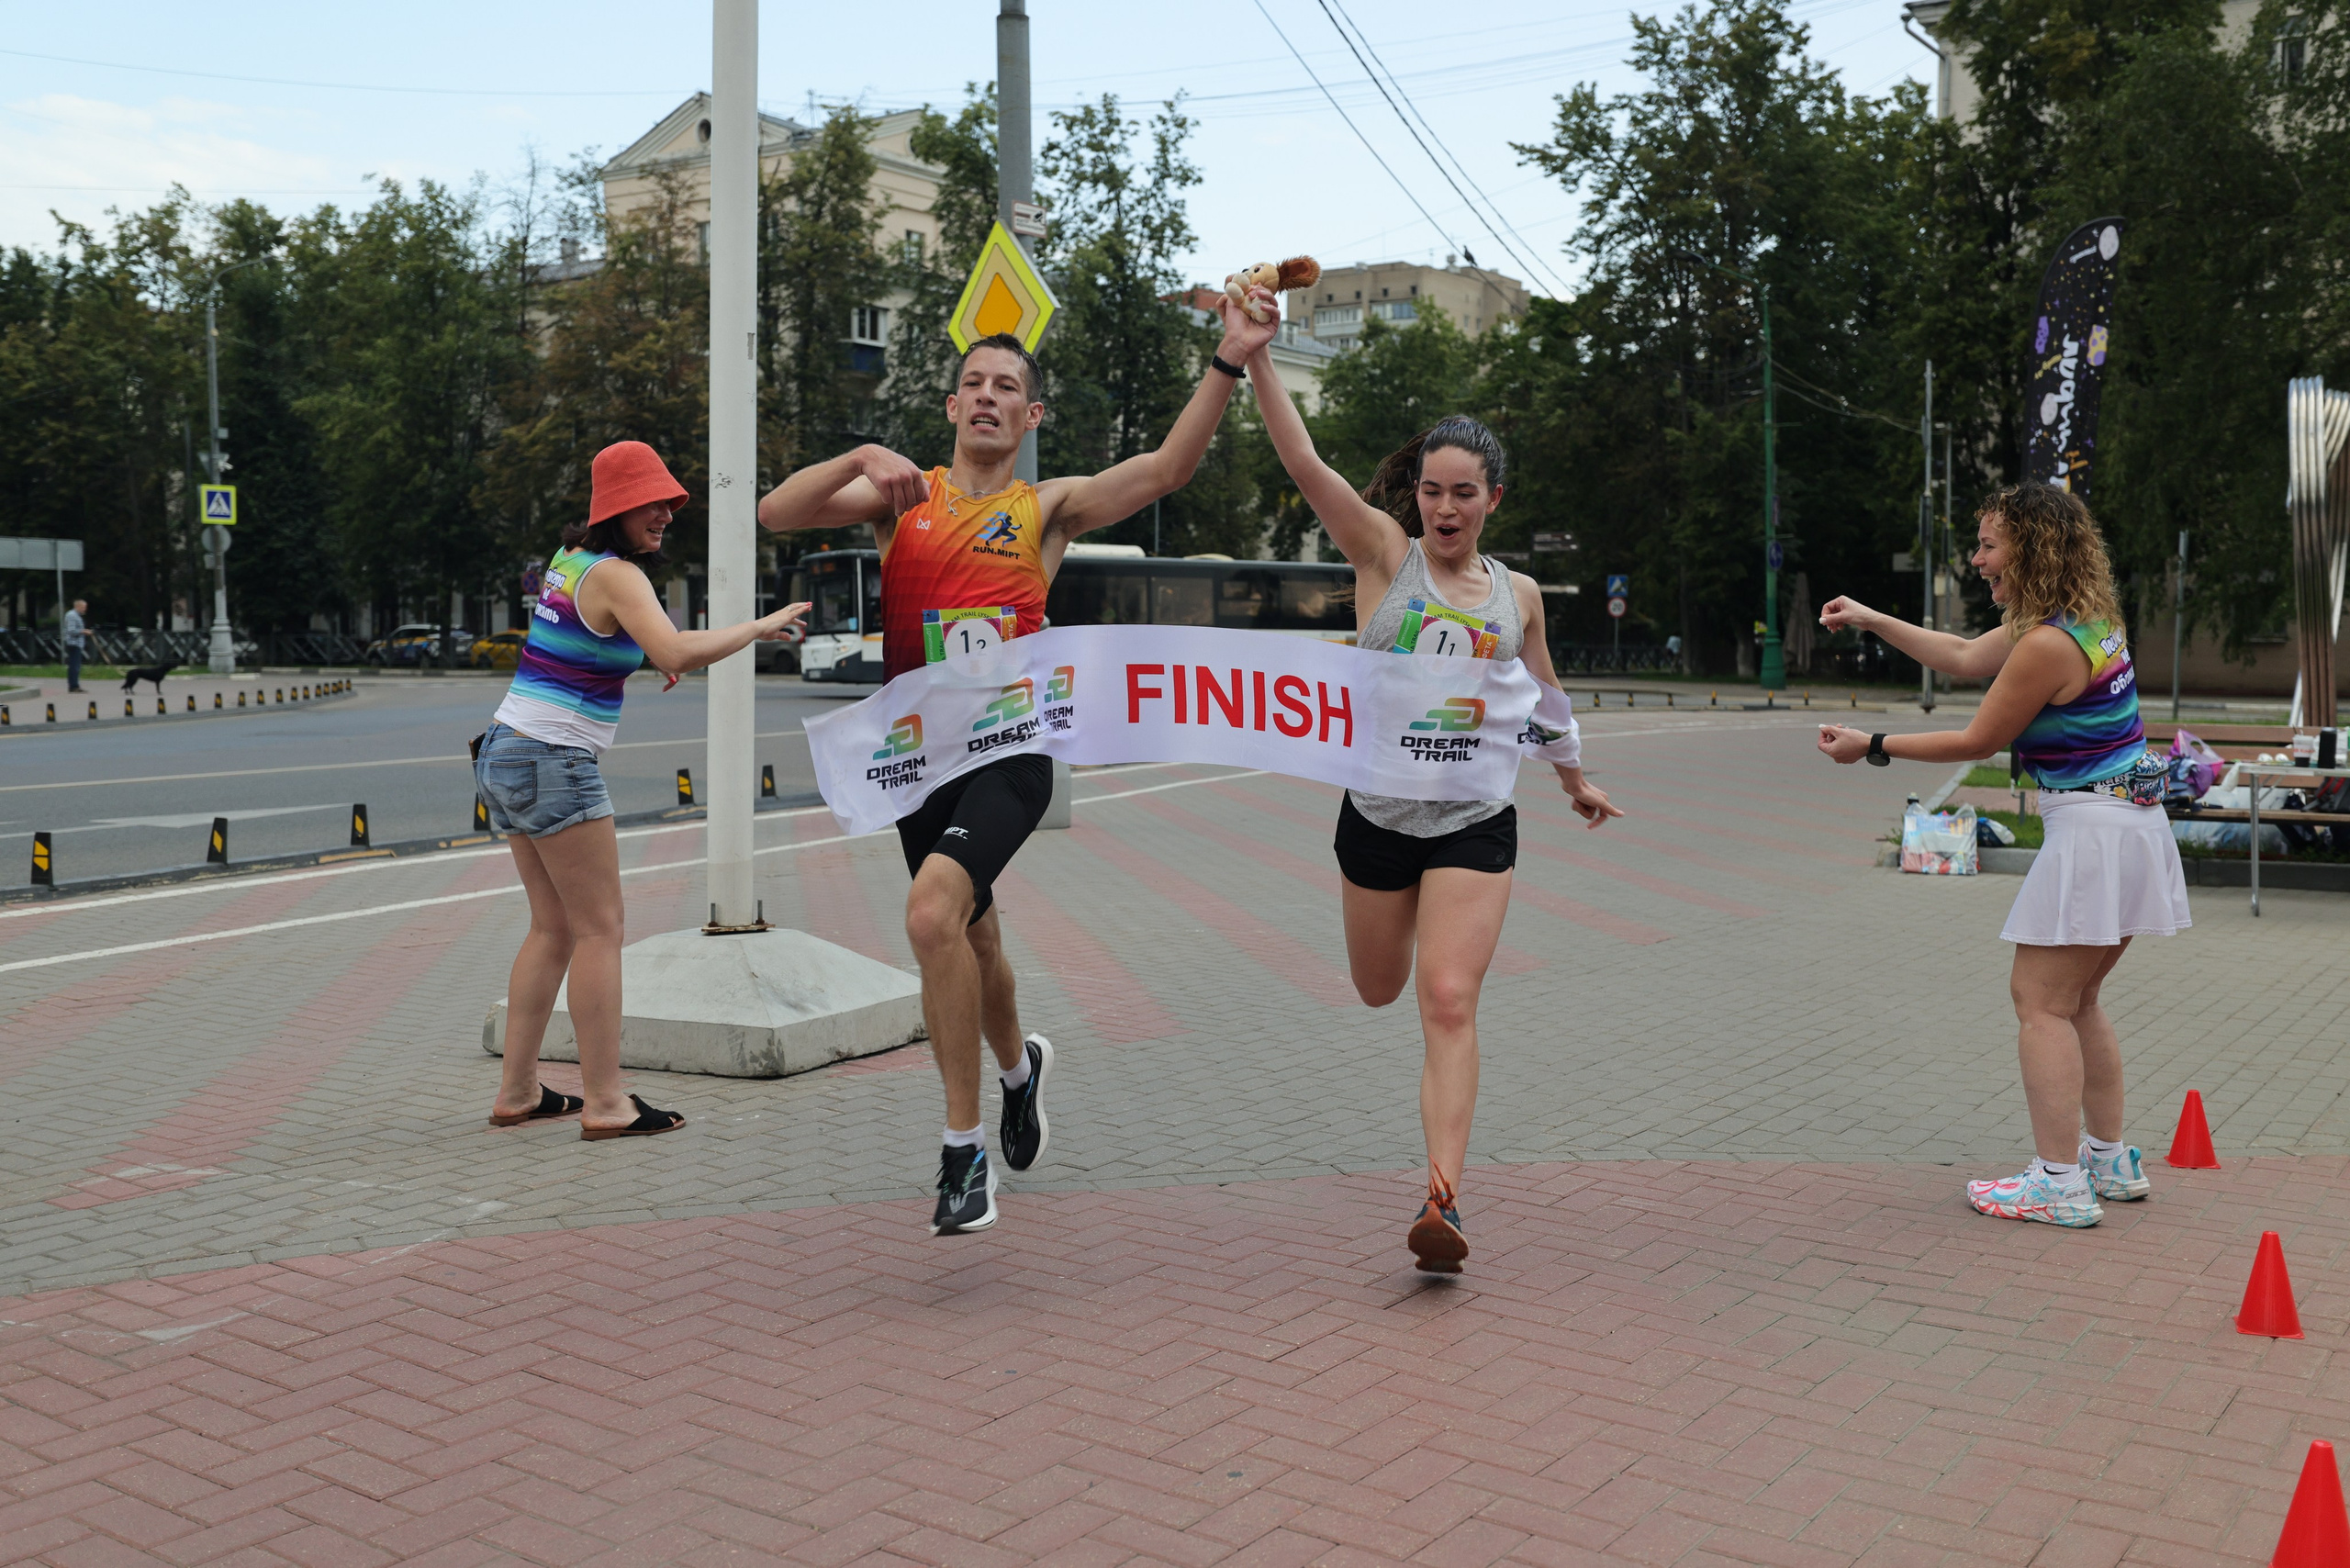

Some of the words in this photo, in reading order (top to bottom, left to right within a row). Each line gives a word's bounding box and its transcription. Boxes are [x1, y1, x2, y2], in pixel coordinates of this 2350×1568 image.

[973, 546, 1020, 560] RUN.MIPT
[1444, 612, 1460, 622] TRAIL
[960, 630, 969, 655] 1
[976, 638, 987, 655] 2
[1436, 630, 1449, 655] 1
[1449, 643, 1456, 656] 1
[1125, 663, 1353, 748] FINISH
[967, 716, 1041, 754] DREAM
[1400, 735, 1481, 758] DREAM
[866, 755, 927, 781] DREAM
[1410, 749, 1473, 763] TRAIL
[877, 770, 923, 791] TRAIL
